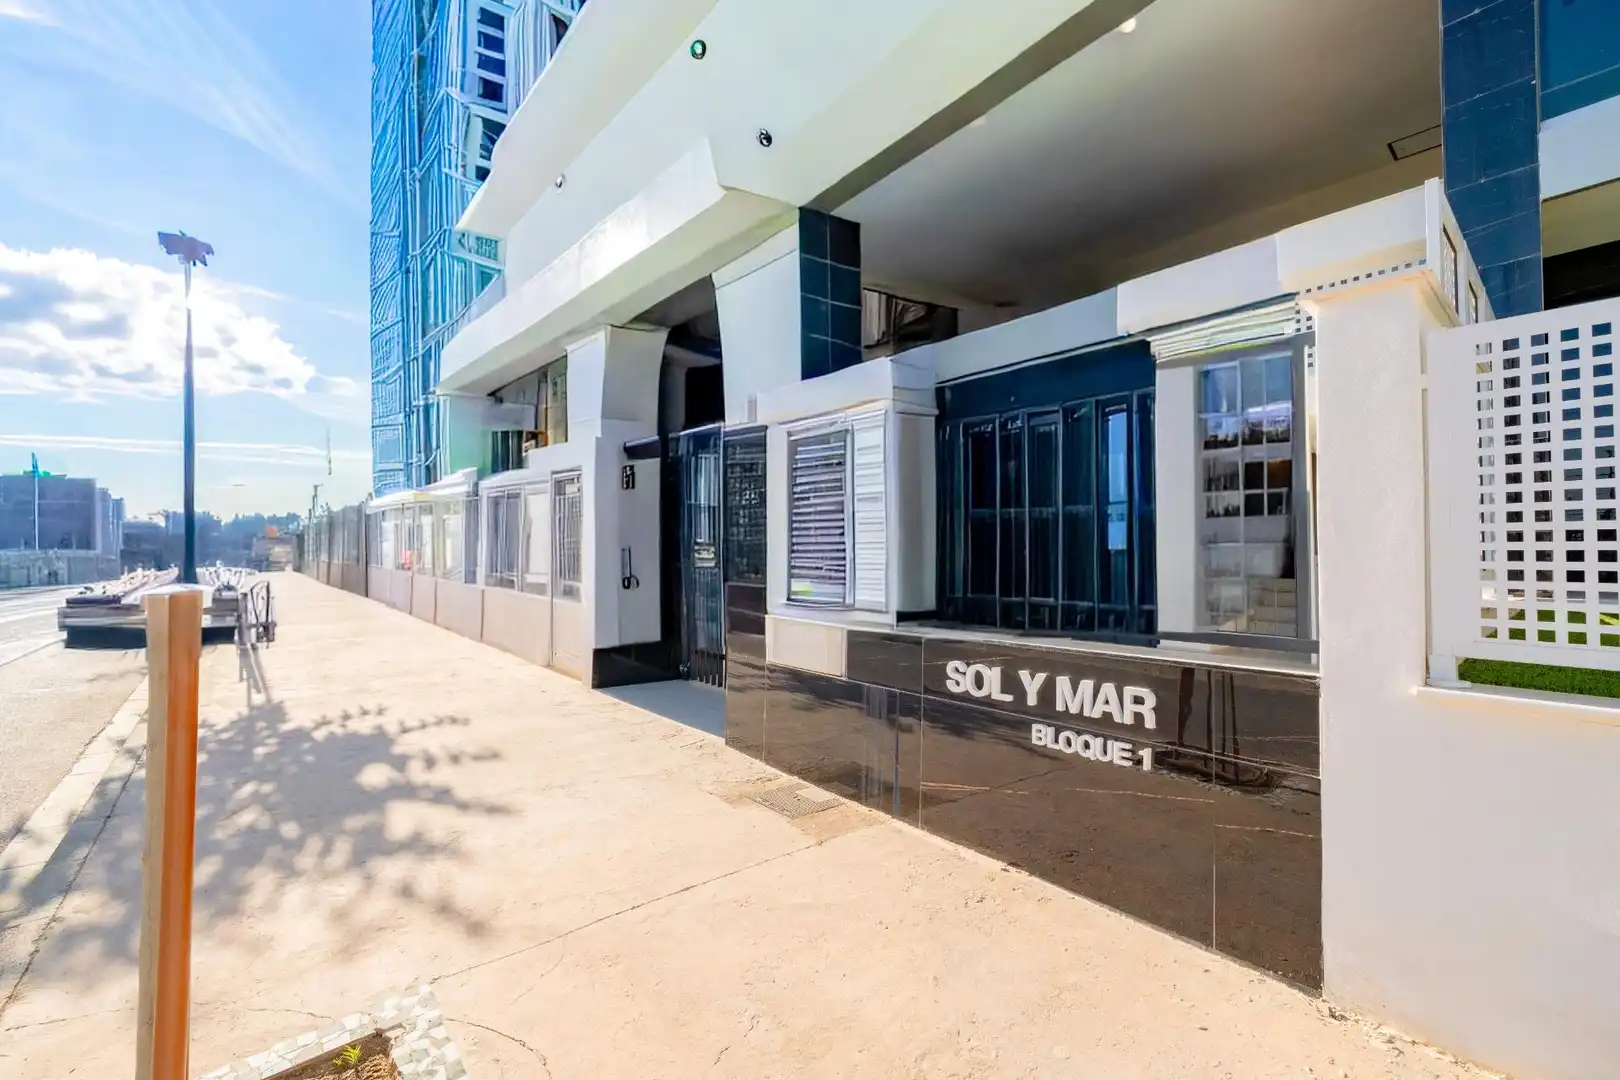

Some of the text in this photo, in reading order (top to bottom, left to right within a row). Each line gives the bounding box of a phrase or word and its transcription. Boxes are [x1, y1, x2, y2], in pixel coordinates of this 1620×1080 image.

[946, 660, 1157, 729] SOL Y MAR
[1031, 723, 1152, 770] BLOQUE 1
